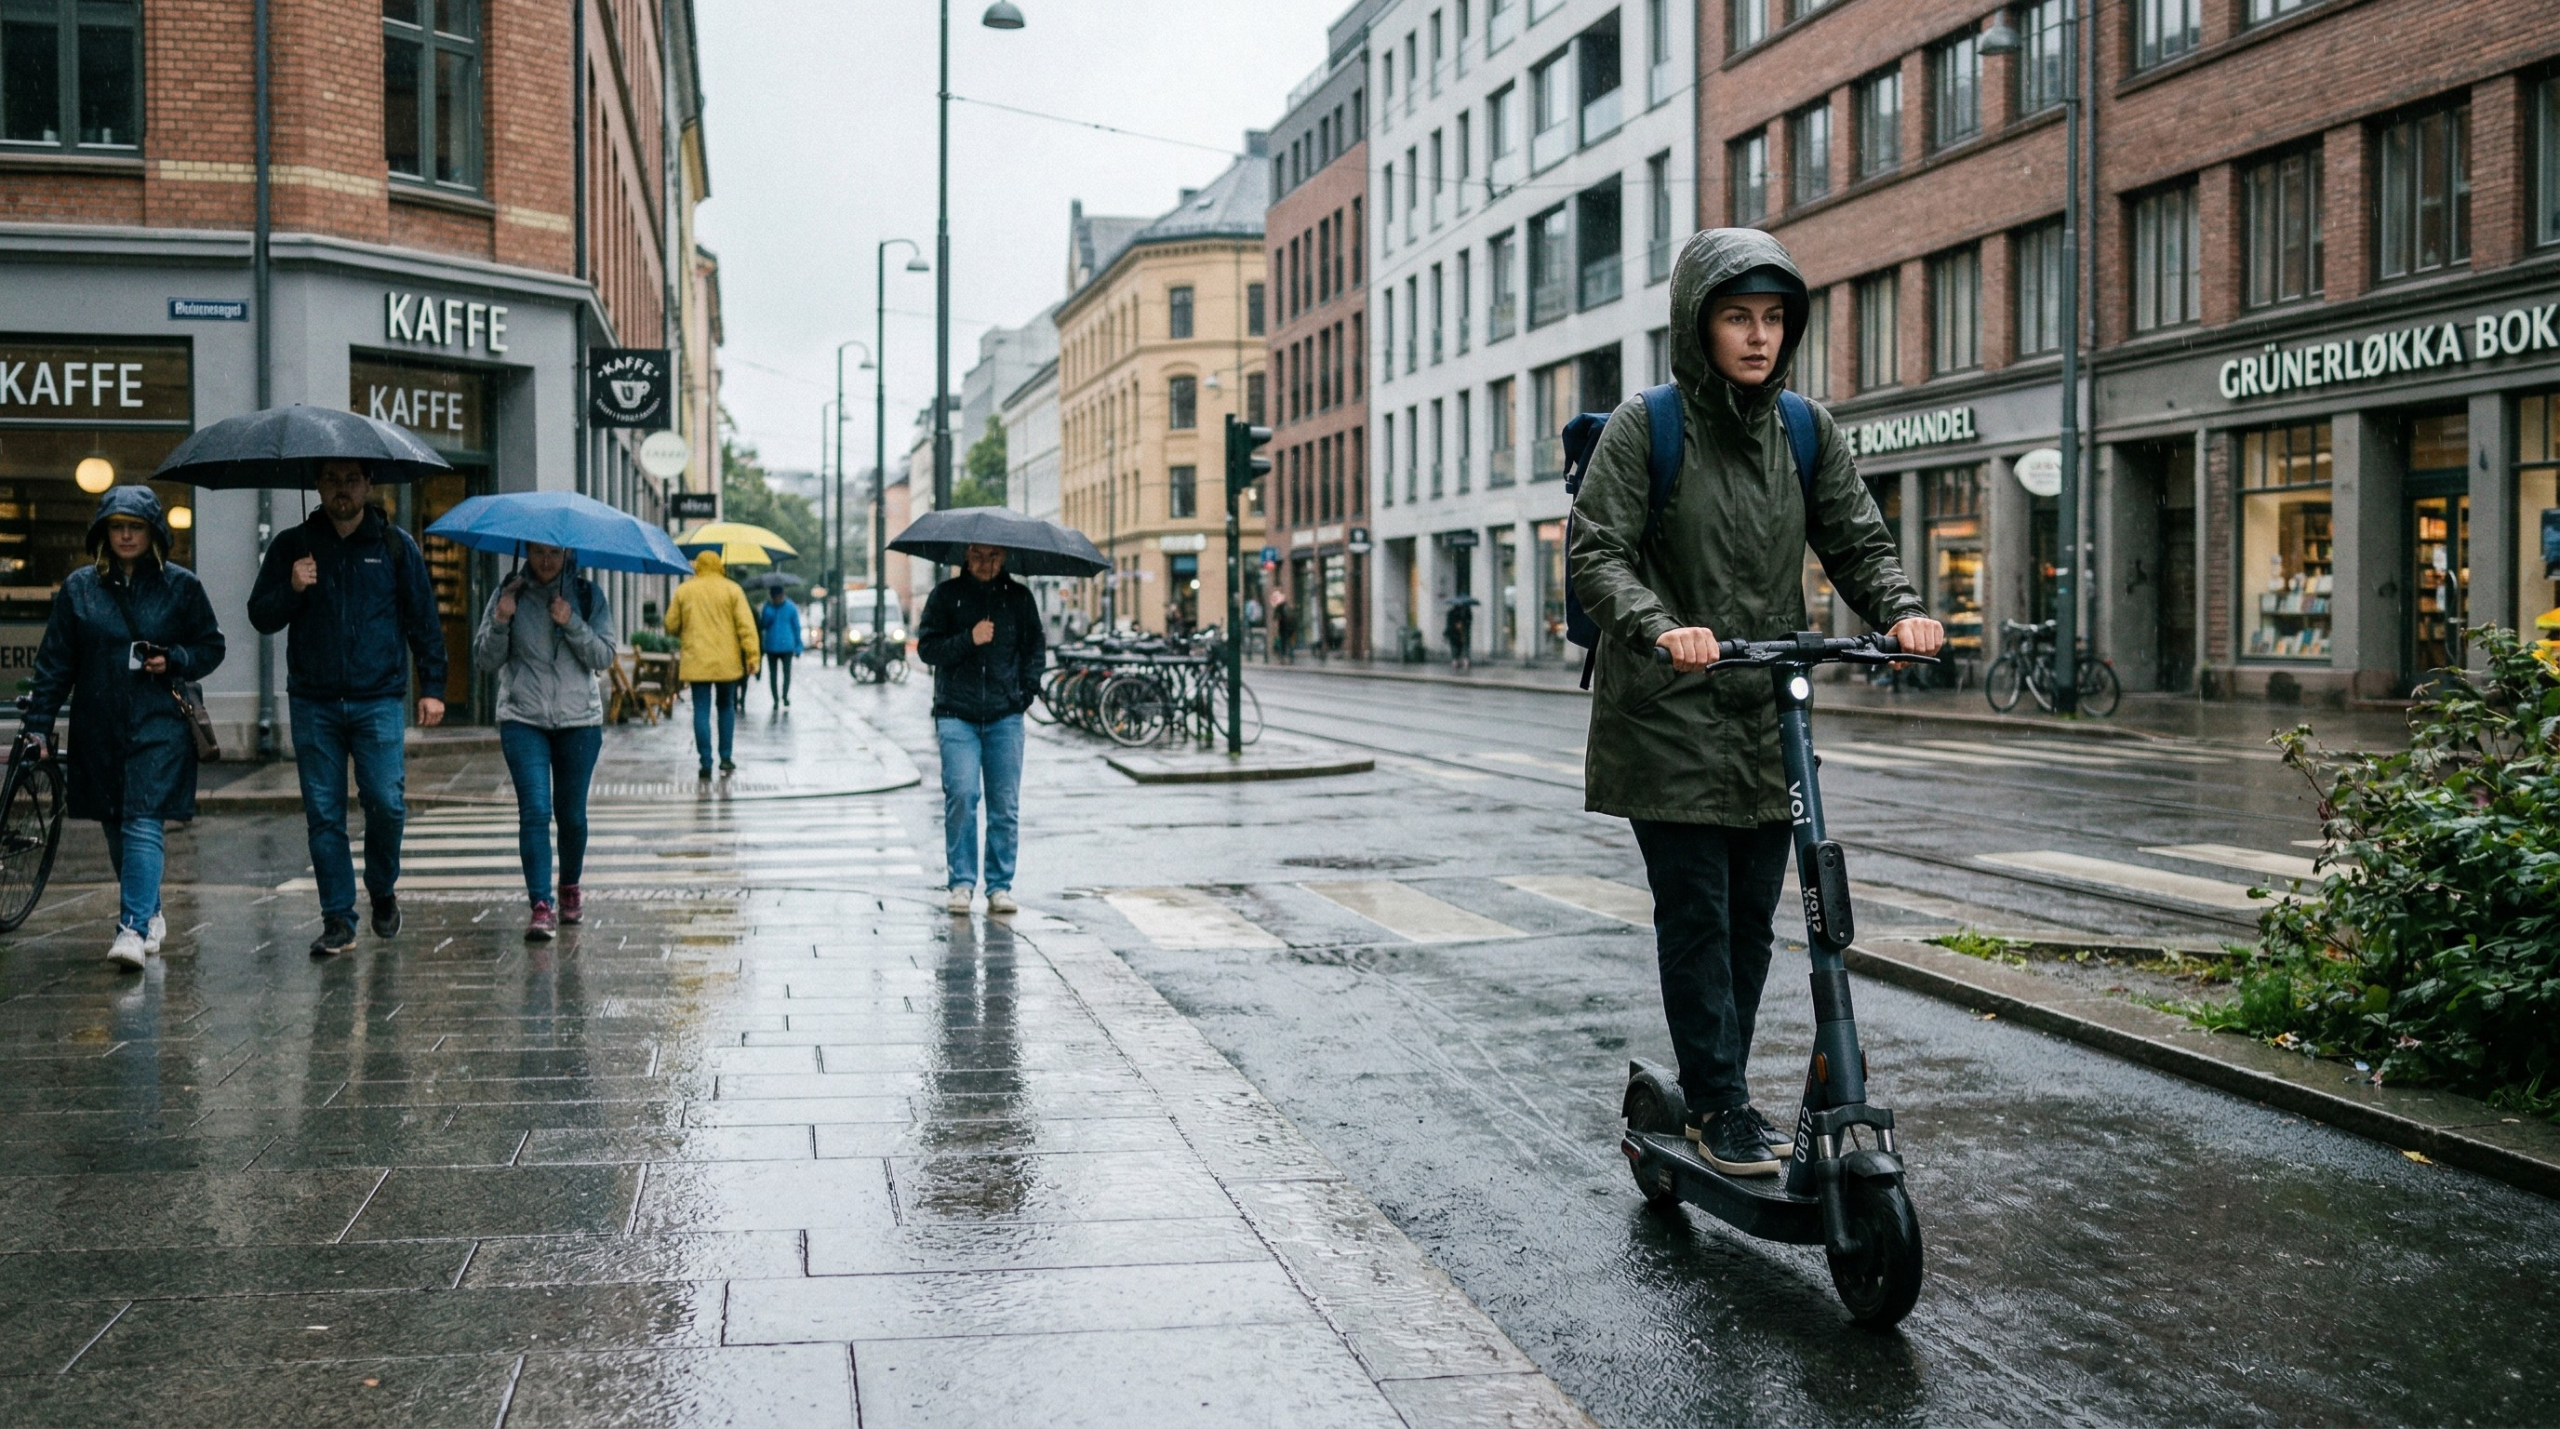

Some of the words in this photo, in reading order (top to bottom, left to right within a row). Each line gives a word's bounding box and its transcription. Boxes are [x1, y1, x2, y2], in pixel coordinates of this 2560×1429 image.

[389, 291, 509, 352] KAFFE
[602, 356, 655, 378] KAFFE
[2219, 322, 2463, 399] GRÜNERLØKKA
[2475, 304, 2560, 360] BOK
[0, 361, 144, 408] KAFFE
[370, 384, 464, 430] KAFFE
[1860, 406, 1975, 455] BOKHANDEL
[1789, 780, 1812, 827] voi
